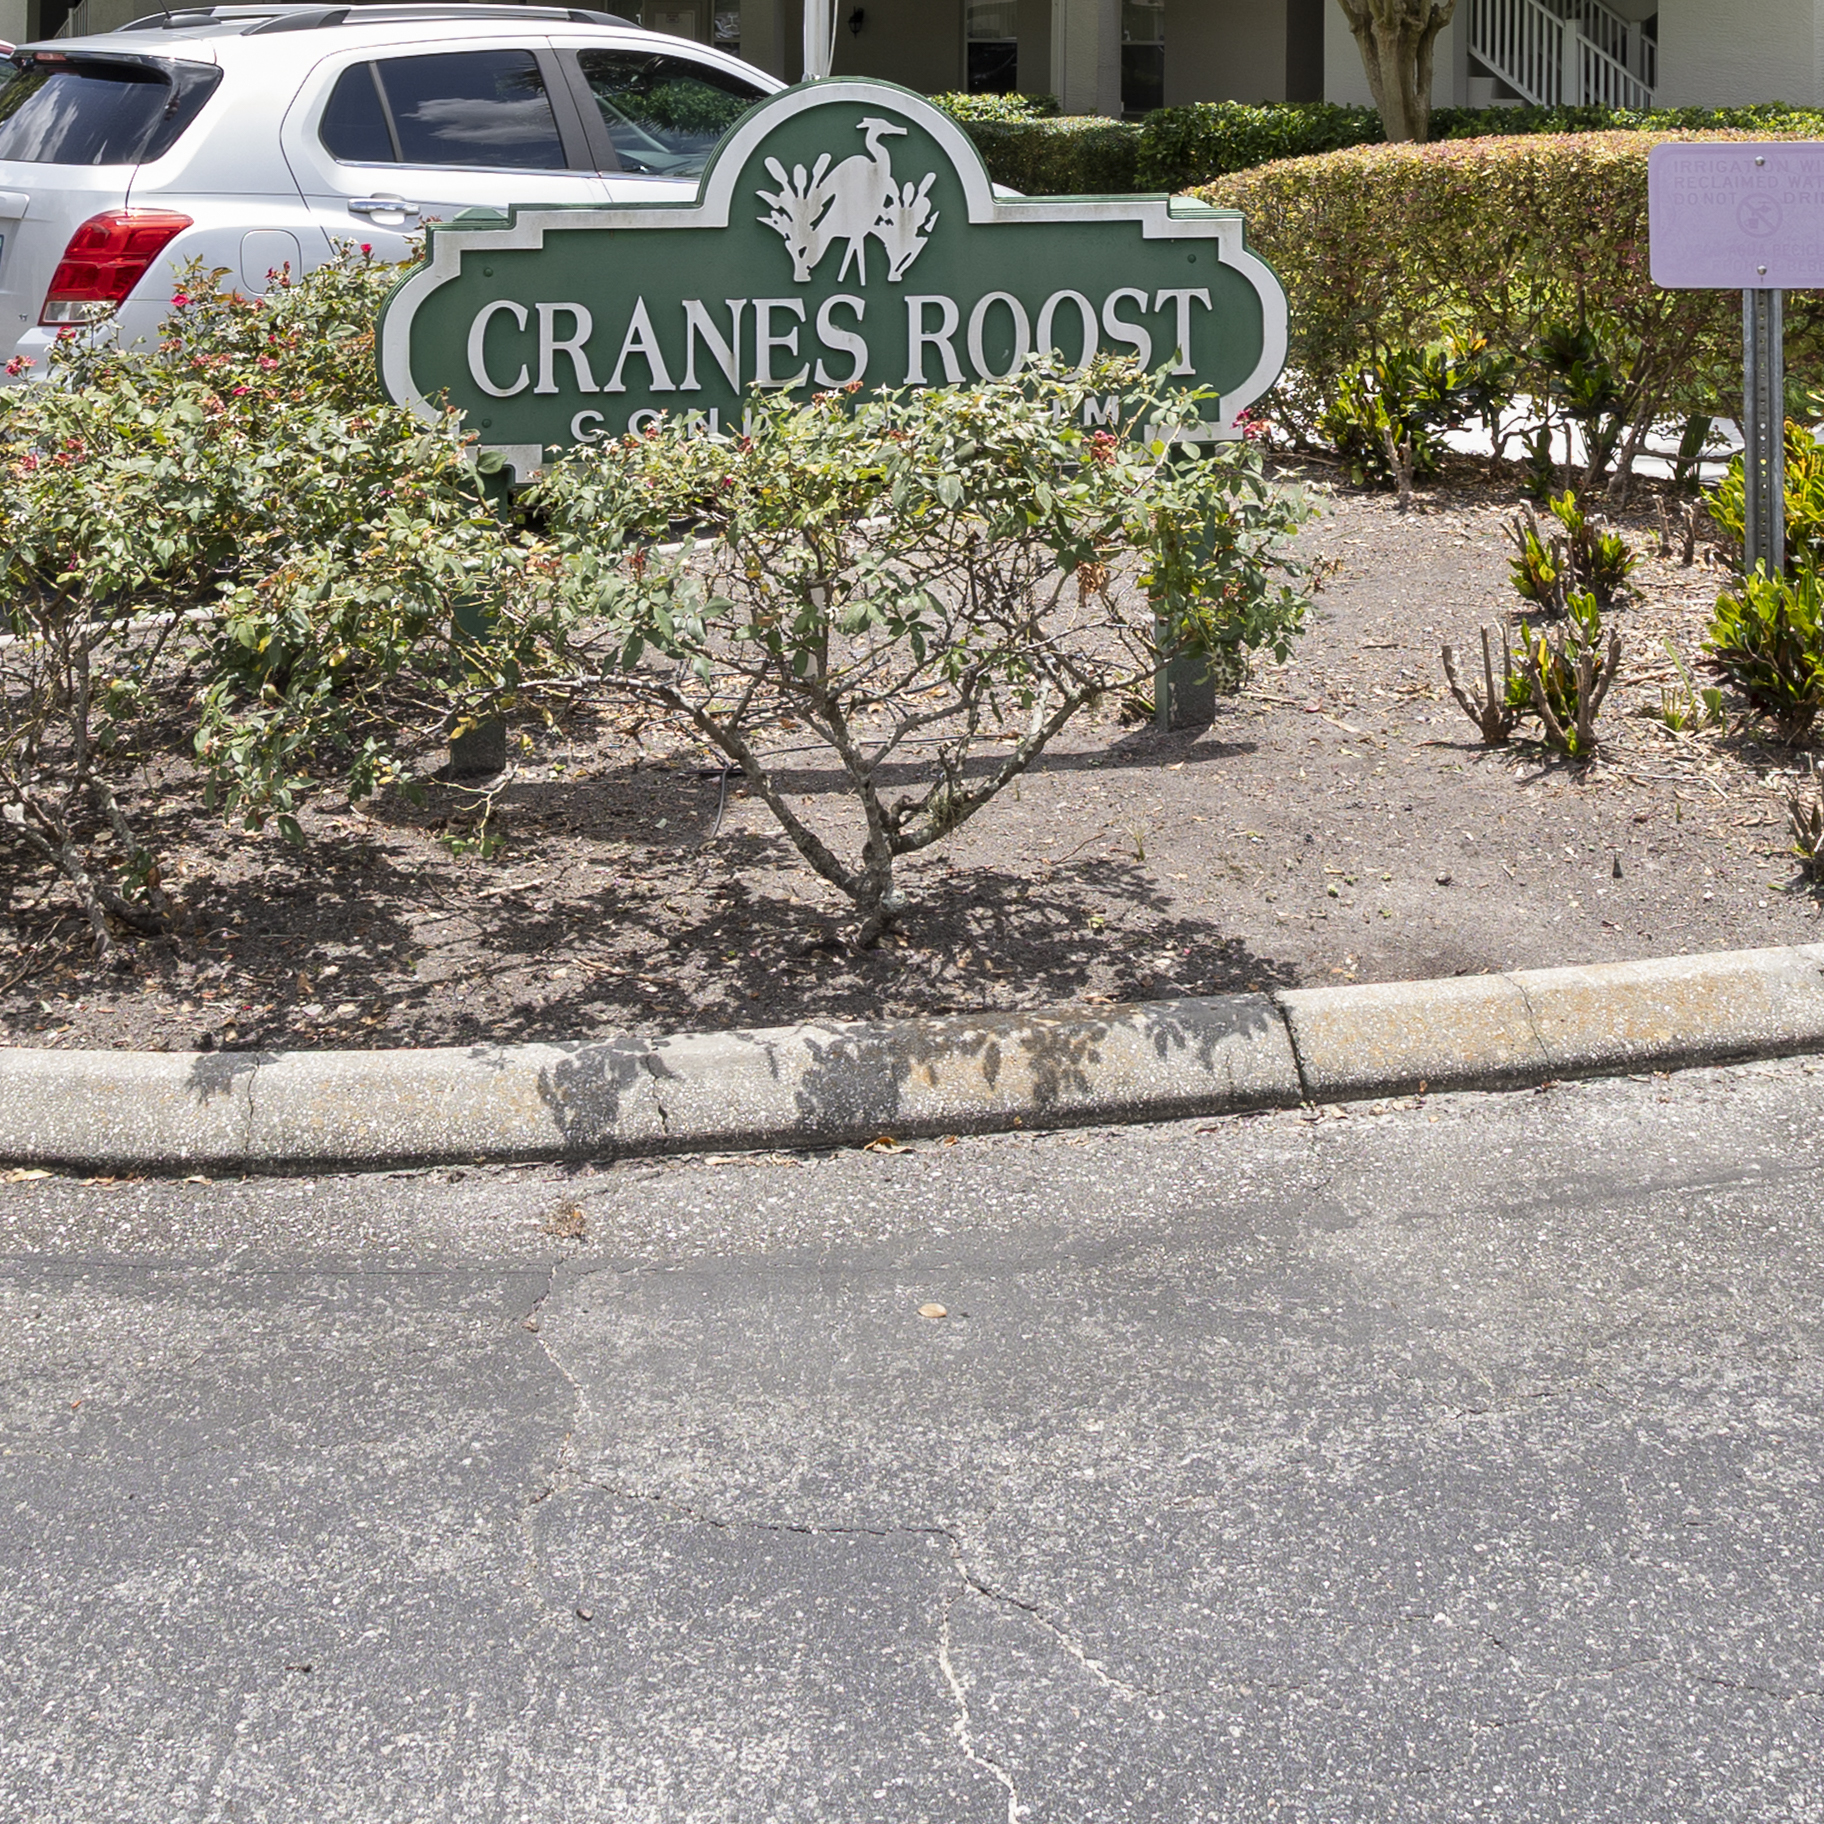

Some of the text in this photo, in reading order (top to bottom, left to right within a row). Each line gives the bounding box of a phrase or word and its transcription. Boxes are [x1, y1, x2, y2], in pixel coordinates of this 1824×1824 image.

[1674, 159, 1789, 173] IRRIGATION
[1674, 175, 1779, 189] RECLAIMED
[1674, 192, 1698, 206] DO
[1703, 192, 1737, 205] NOT
[467, 287, 1213, 398] CRANES ROOST
